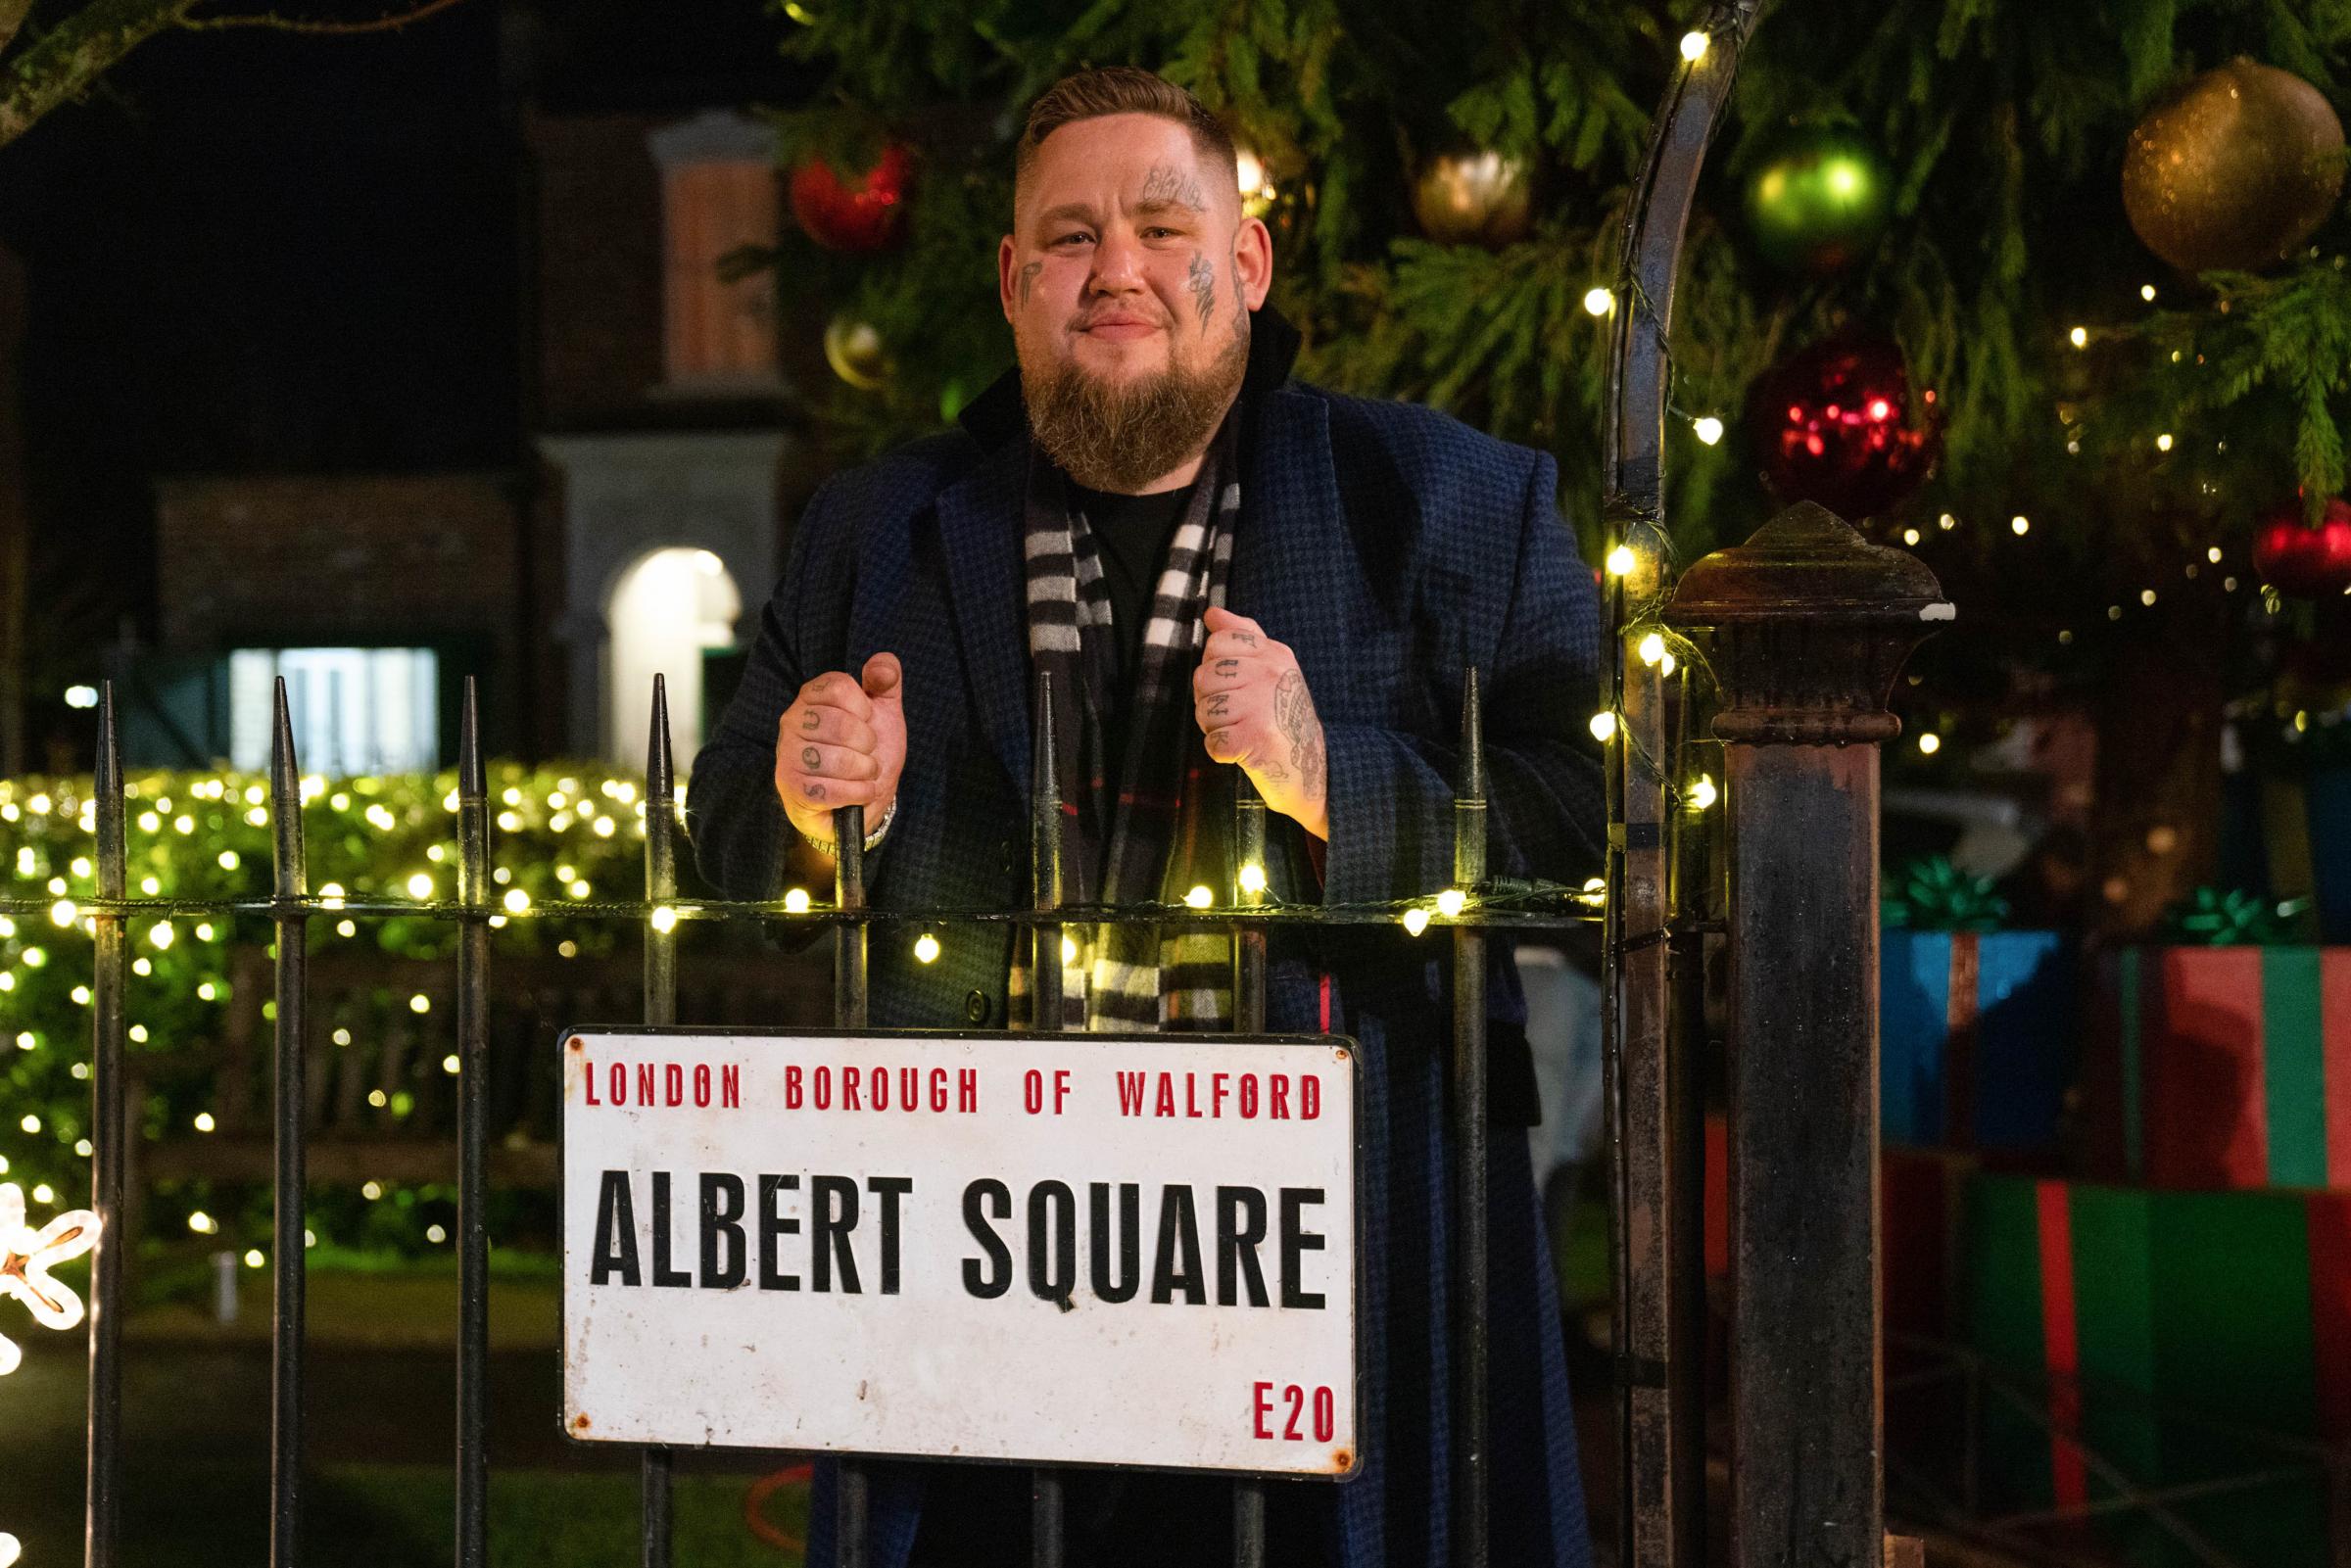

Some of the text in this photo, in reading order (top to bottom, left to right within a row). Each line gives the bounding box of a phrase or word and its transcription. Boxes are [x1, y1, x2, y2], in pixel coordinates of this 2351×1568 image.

[1207, 632, 1257, 746] FUNK
[585, 1061, 1320, 1120] LONDON BOROUGH OF WALFORD
[590, 1169, 1326, 1313] ALBERT SQUARE
[1253, 1381, 1334, 1443] E20
